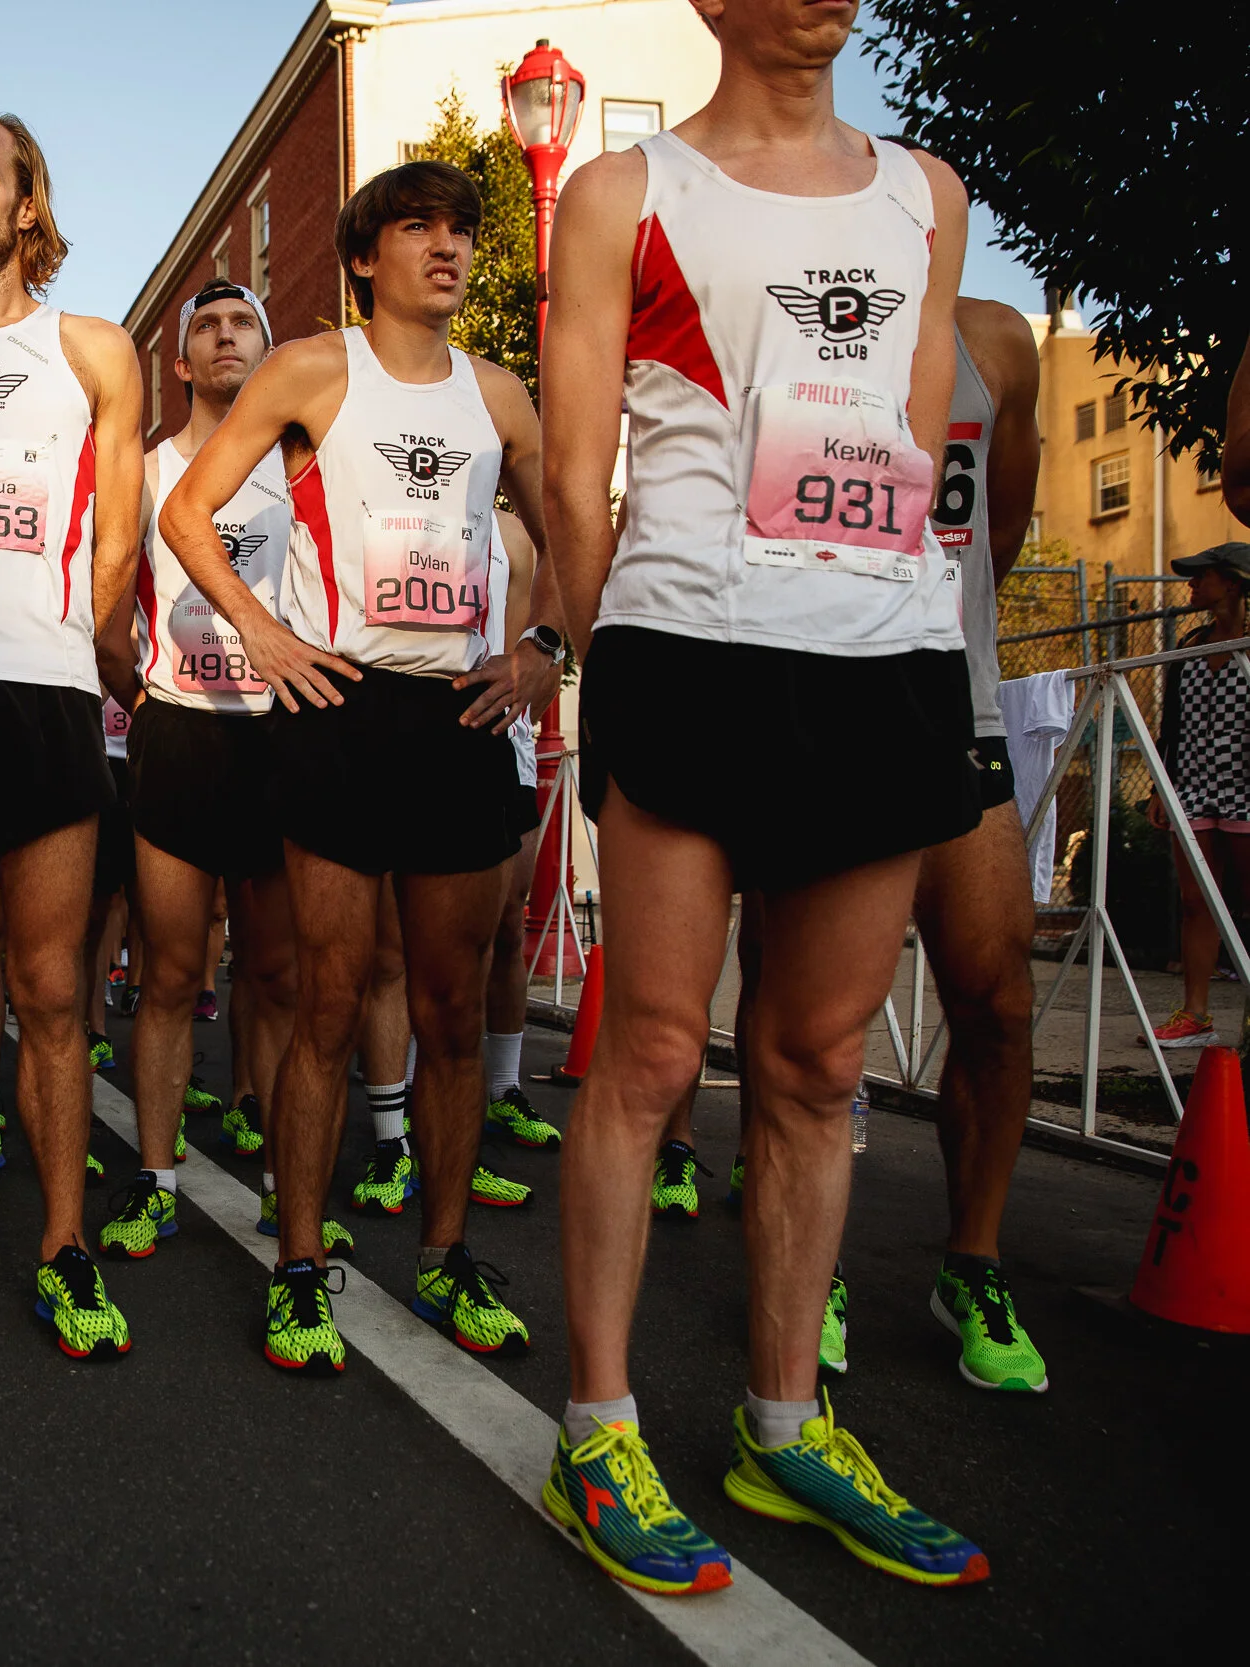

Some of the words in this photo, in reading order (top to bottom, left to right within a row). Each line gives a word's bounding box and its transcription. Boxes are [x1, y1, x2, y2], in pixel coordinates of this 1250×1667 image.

[804, 268, 876, 285] TRACK
[7, 335, 49, 365] DIADORA
[818, 343, 868, 361] CLUB
[796, 382, 849, 406] PHILLY
[850, 388, 861, 397] 10
[400, 434, 447, 448] TRACK
[823, 437, 891, 467] Kevin
[251, 480, 286, 504] DIADORA
[406, 487, 440, 501] CLUB
[794, 474, 902, 536] 931
[213, 523, 246, 533] RACK
[387, 517, 423, 530] PHILLY
[462, 528, 472, 541] A
[936, 532, 967, 543] RSEY
[410, 551, 449, 572] Dylan
[892, 567, 913, 578] 931
[376, 576, 482, 617] 2004
